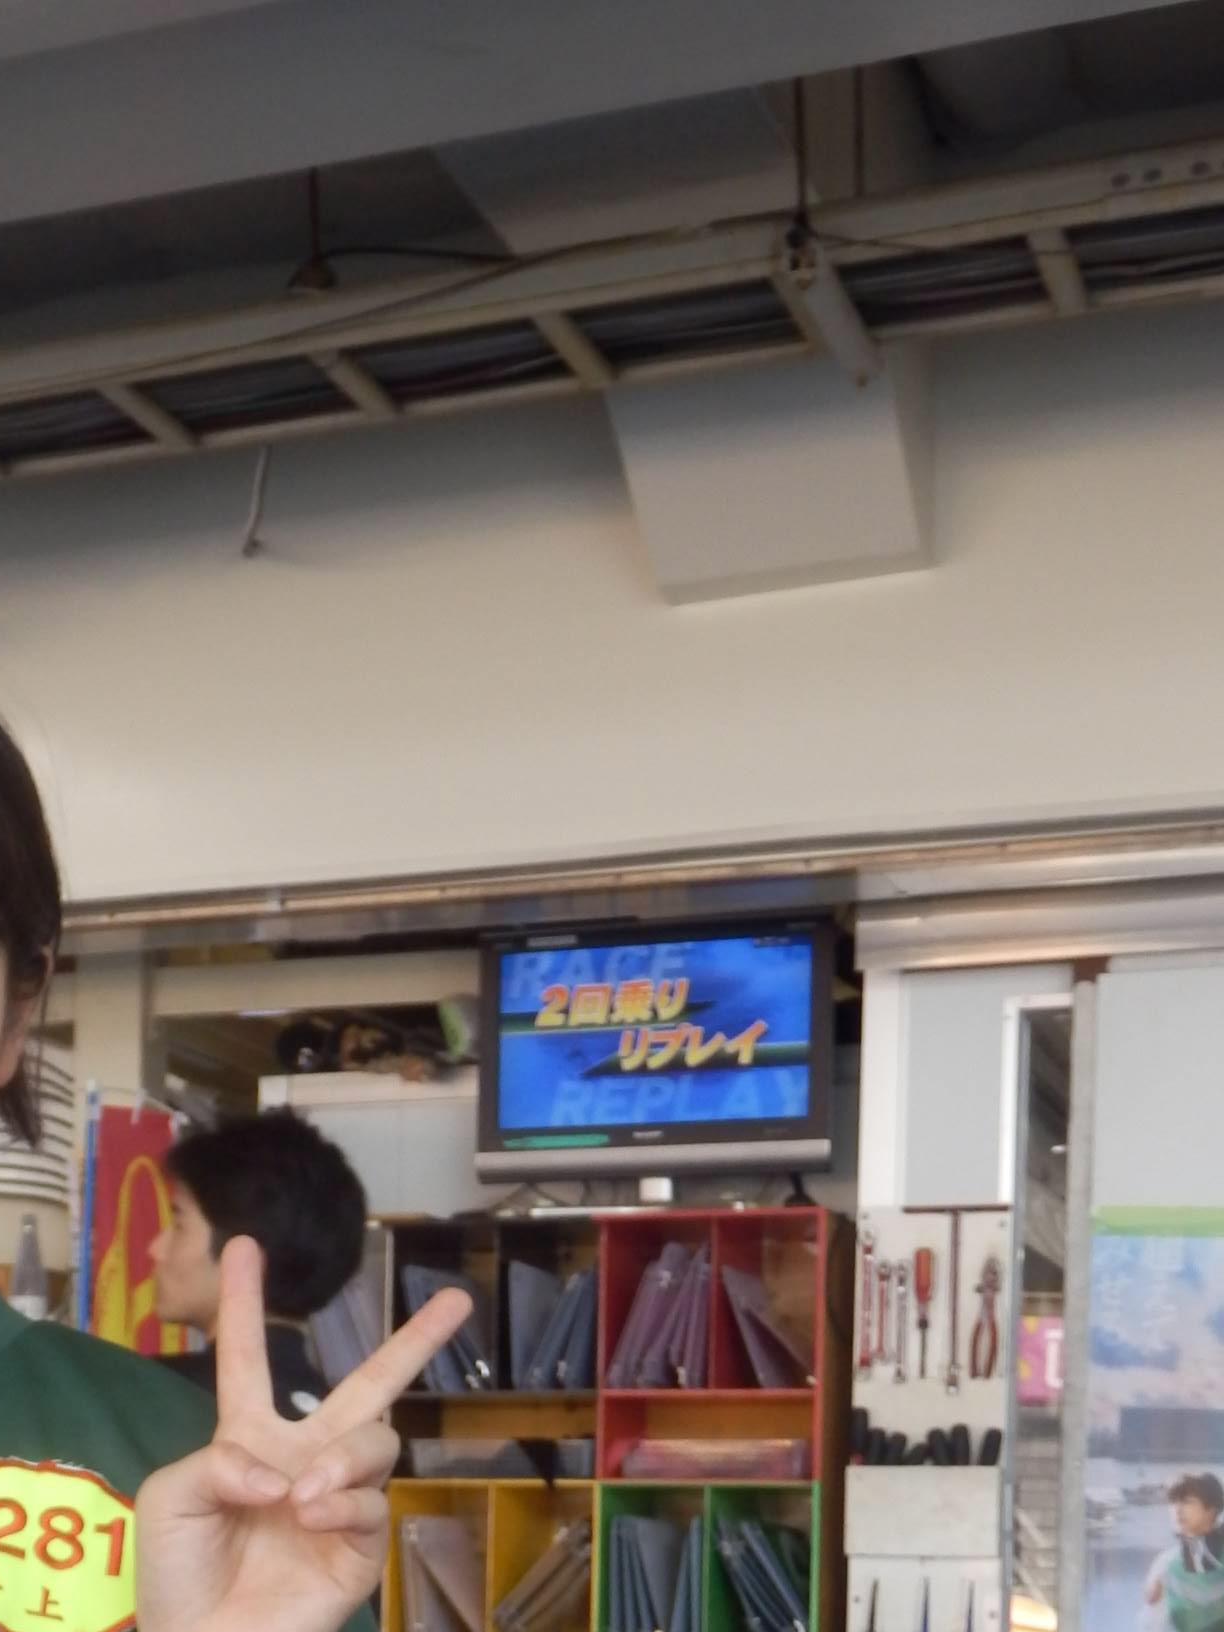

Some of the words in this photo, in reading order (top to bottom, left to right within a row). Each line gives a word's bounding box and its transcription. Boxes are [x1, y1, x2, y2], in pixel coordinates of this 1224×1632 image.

[535, 977, 690, 1027] 2回乗り
[618, 1019, 769, 1072] リプレイ
